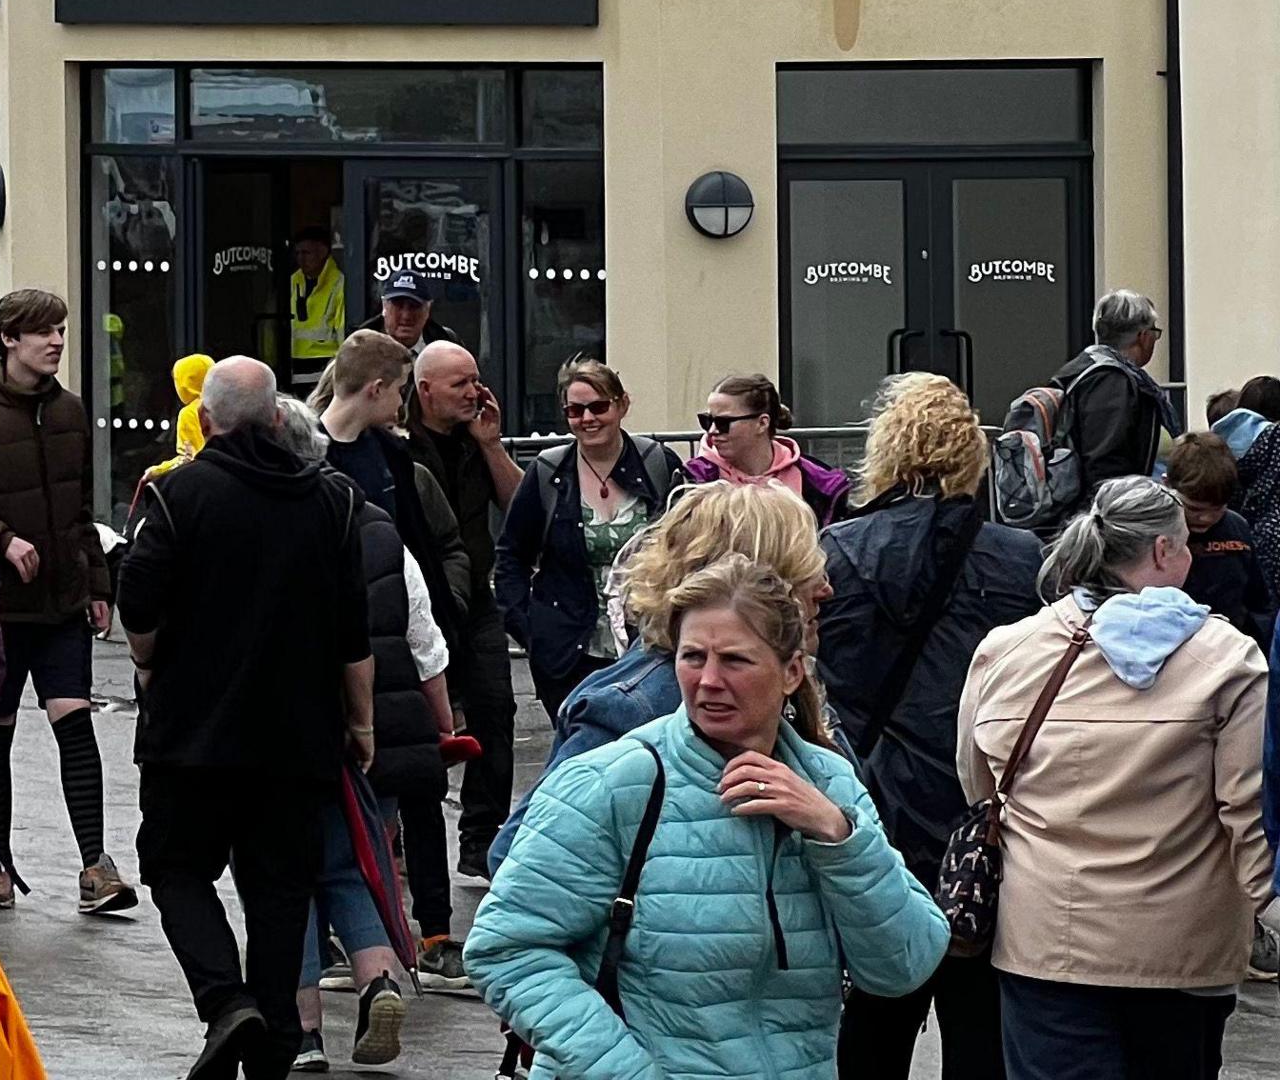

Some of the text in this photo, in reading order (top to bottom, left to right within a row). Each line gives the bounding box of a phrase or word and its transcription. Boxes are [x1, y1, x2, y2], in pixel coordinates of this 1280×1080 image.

[213, 246, 273, 275] BUTCOMBE
[373, 252, 480, 282] BUTCOMBE
[804, 262, 892, 284] BUTCOMBE
[968, 260, 1055, 282] BUTCOMBE
